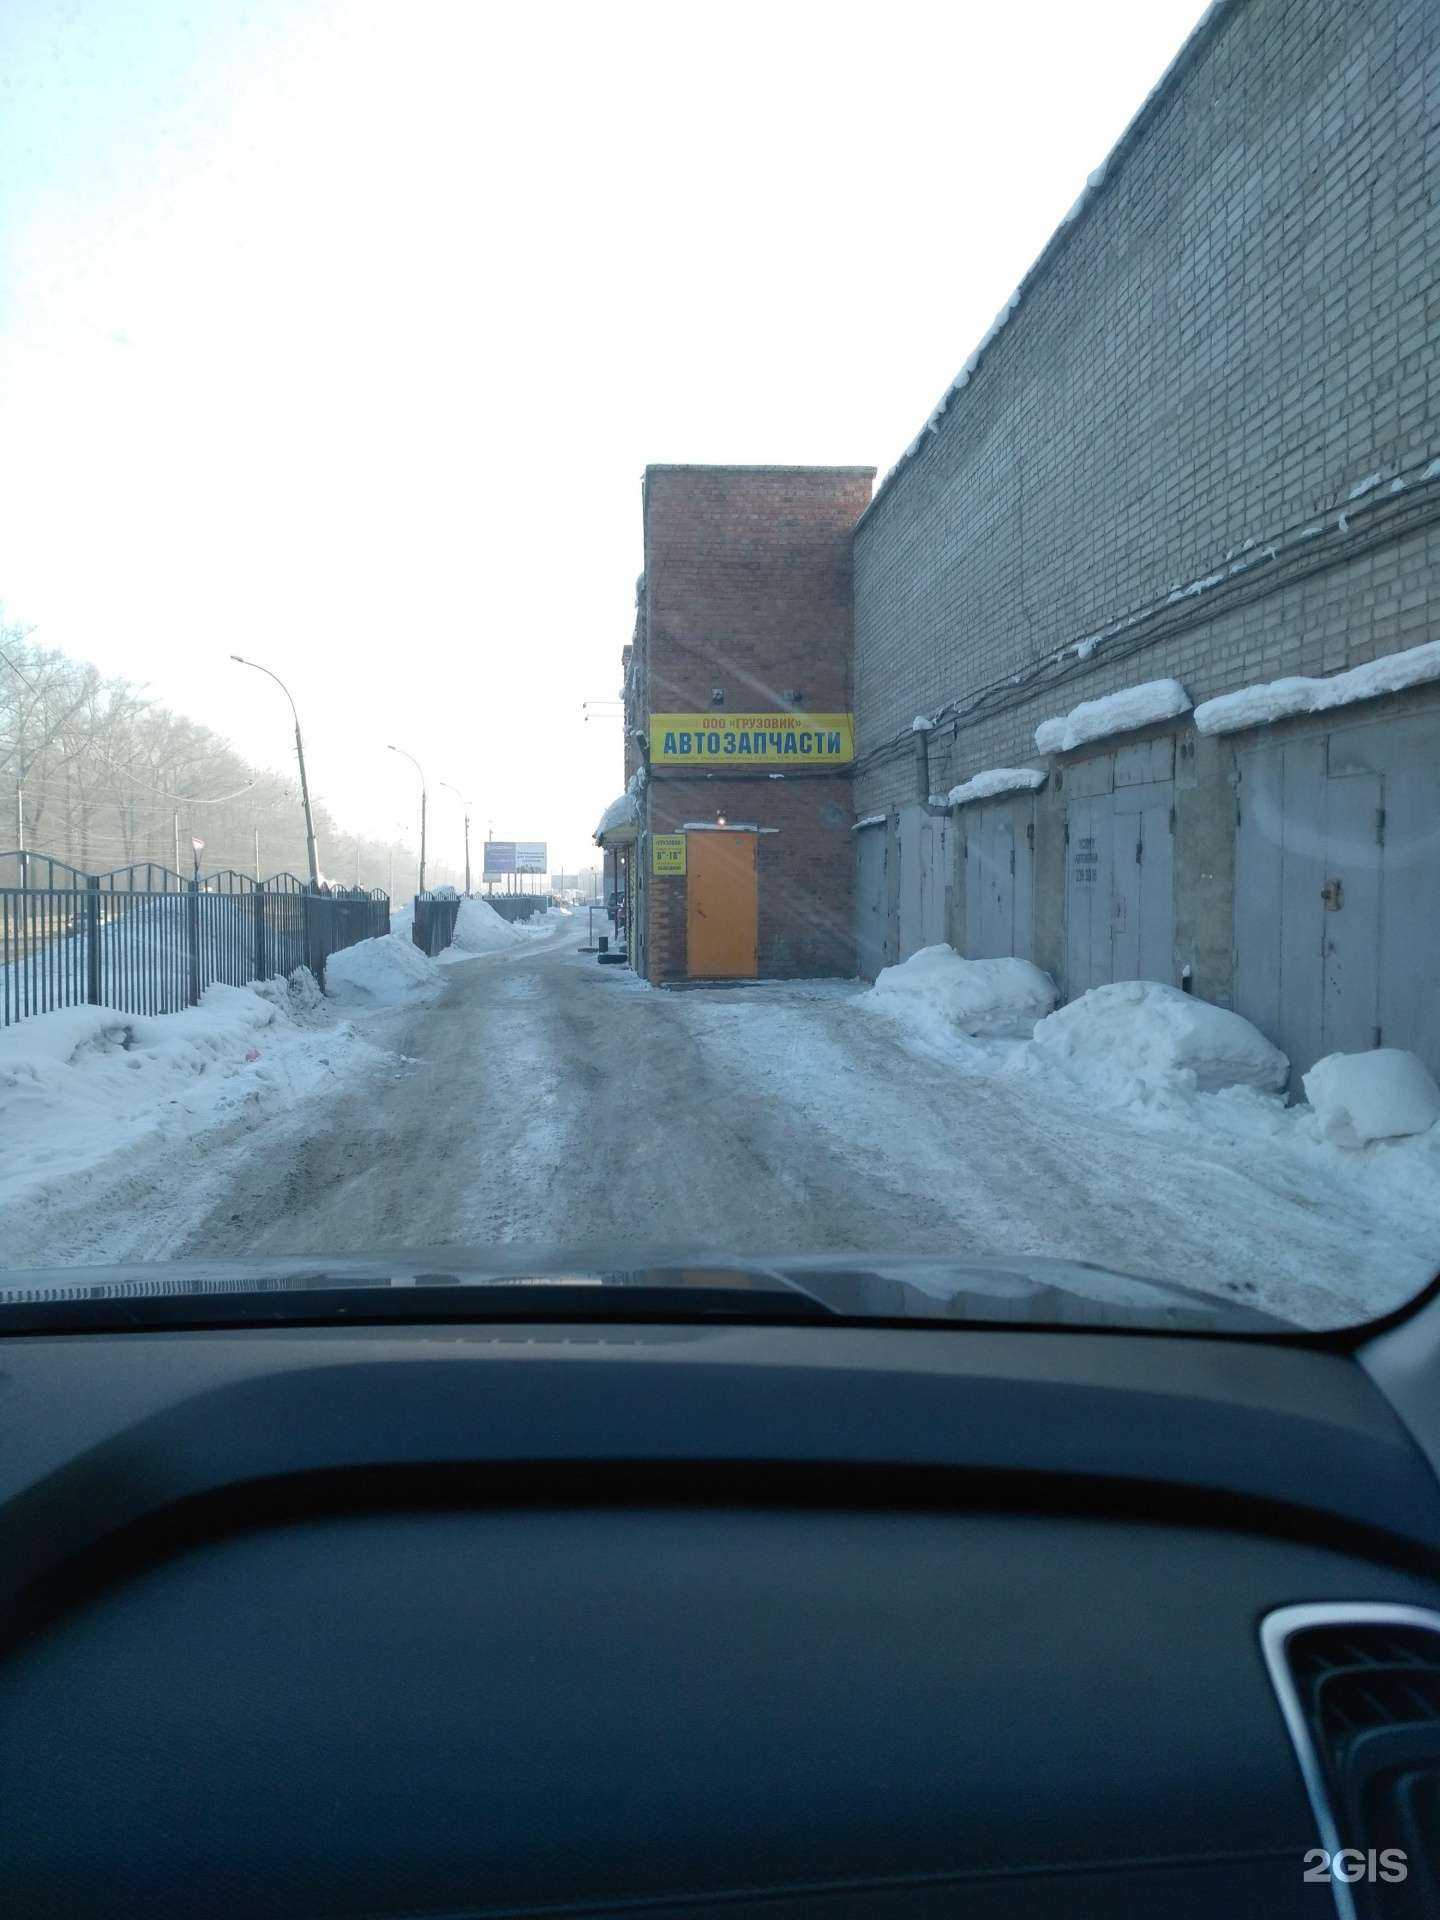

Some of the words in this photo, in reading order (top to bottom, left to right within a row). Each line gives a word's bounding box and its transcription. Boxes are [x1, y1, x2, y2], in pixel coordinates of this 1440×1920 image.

[702, 718, 726, 729] ООО
[729, 718, 802, 729] «ГРУЗОВИК»
[663, 731, 841, 754] АВТОЗАПЧАСТИ
